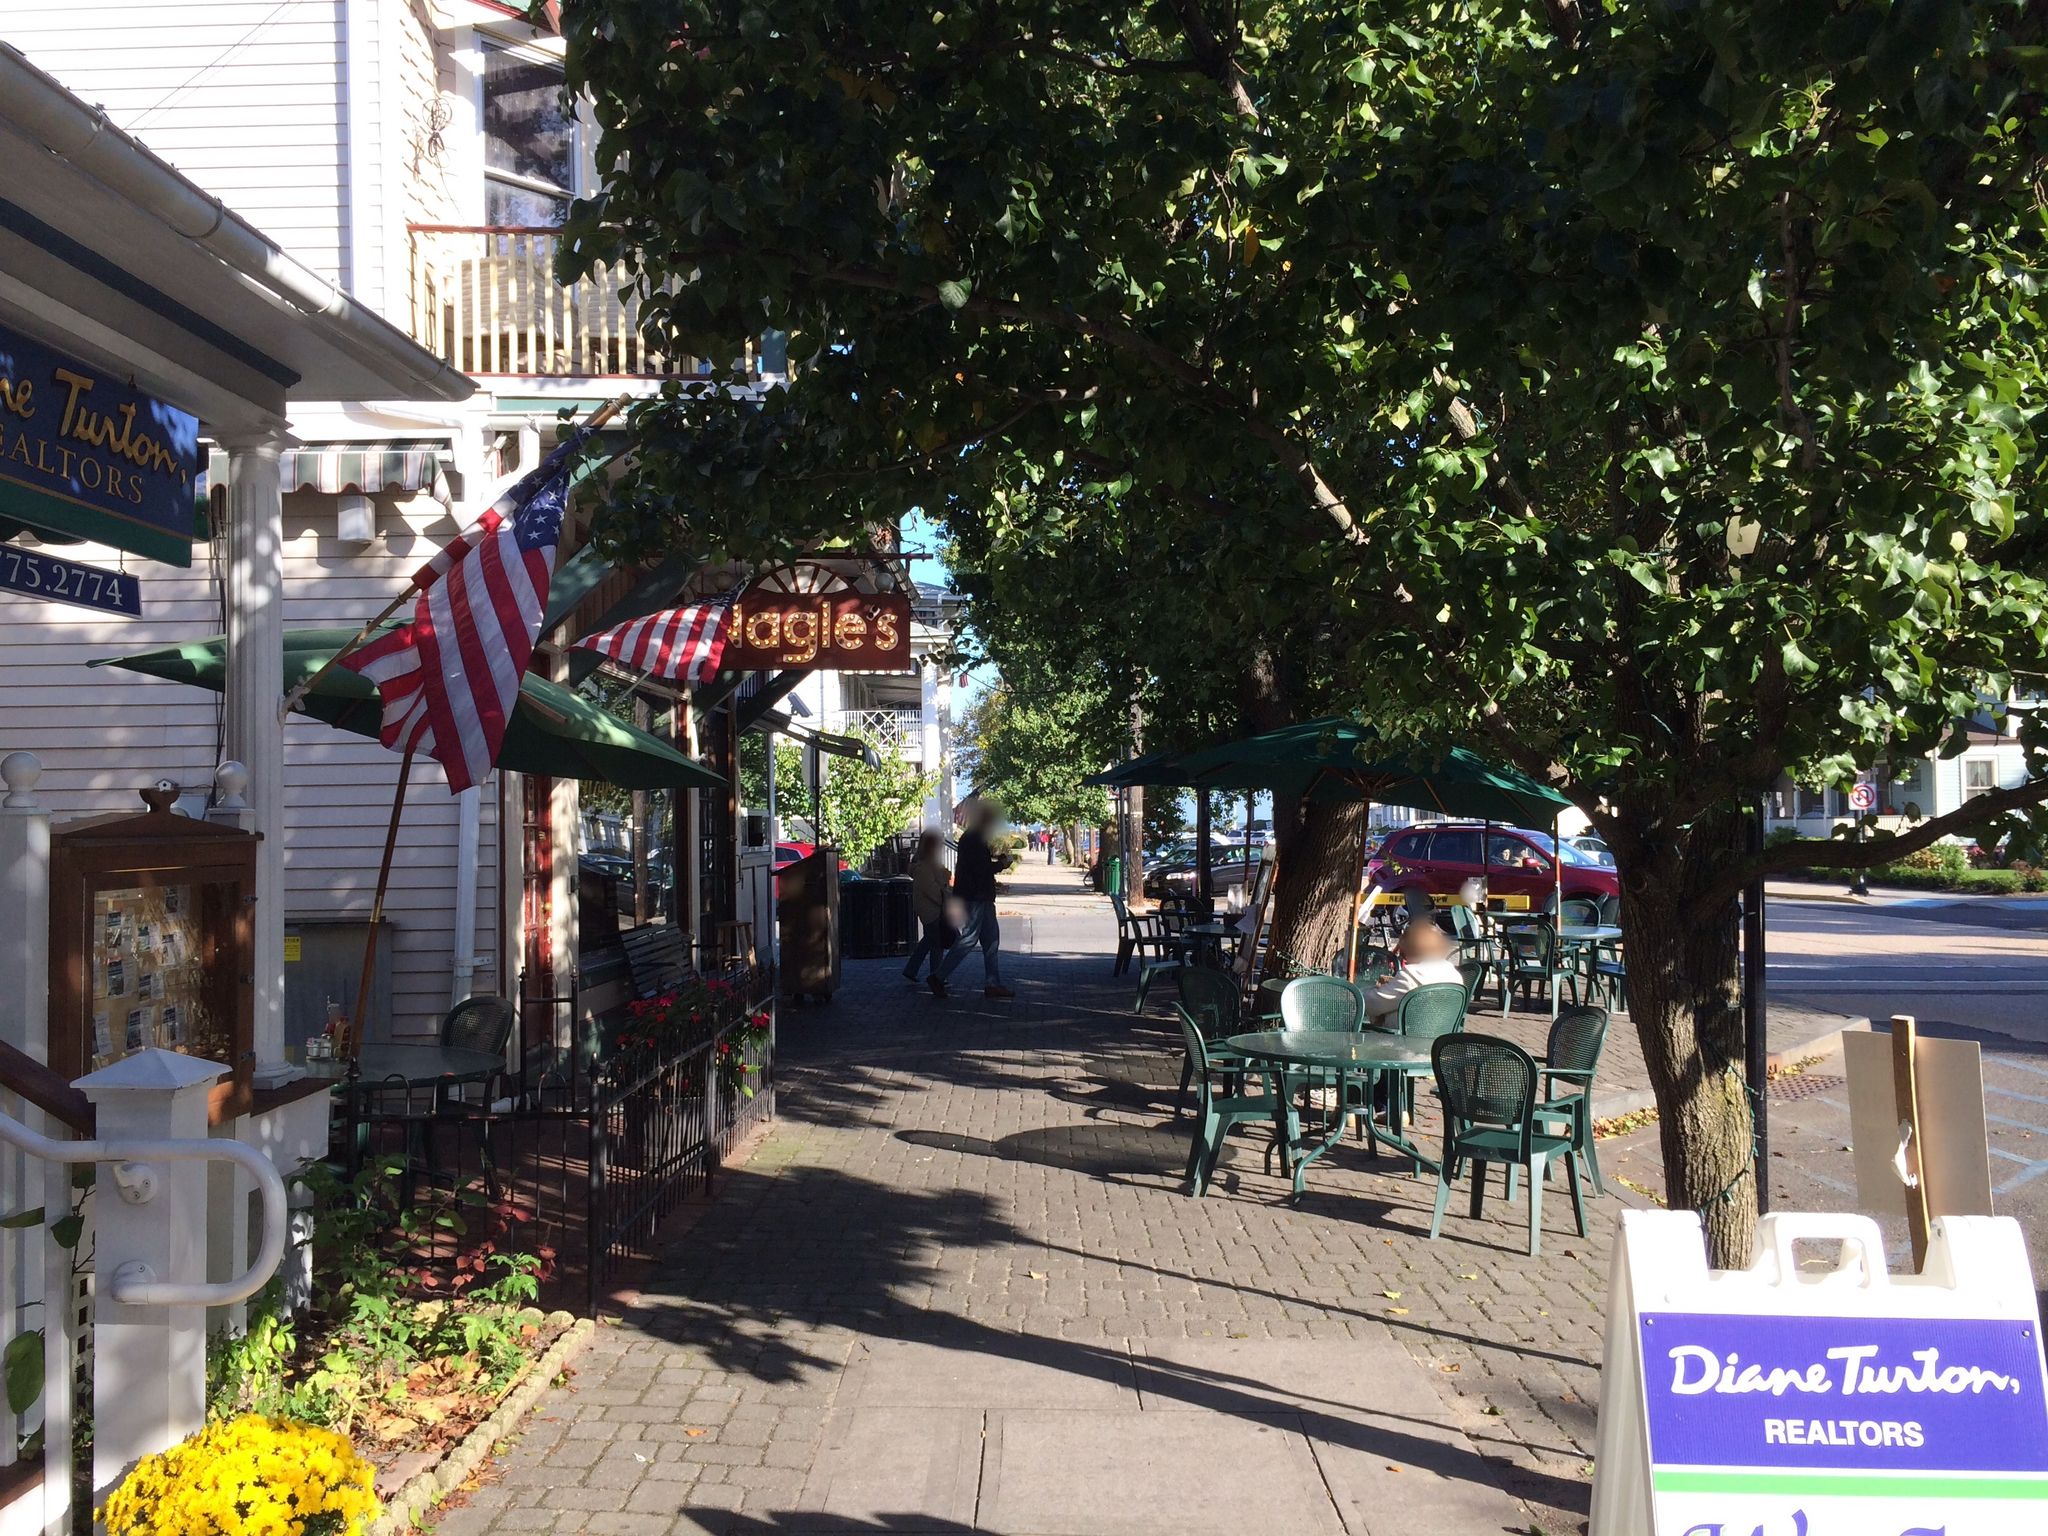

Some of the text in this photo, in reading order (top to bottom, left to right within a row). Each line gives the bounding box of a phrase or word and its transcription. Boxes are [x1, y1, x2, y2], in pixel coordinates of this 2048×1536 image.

[0, 423, 144, 504] ALTORS
[0, 550, 123, 607] 75.2774
[1668, 1344, 1833, 1398] Diane
[1763, 1418, 1926, 1449] REALTORS
